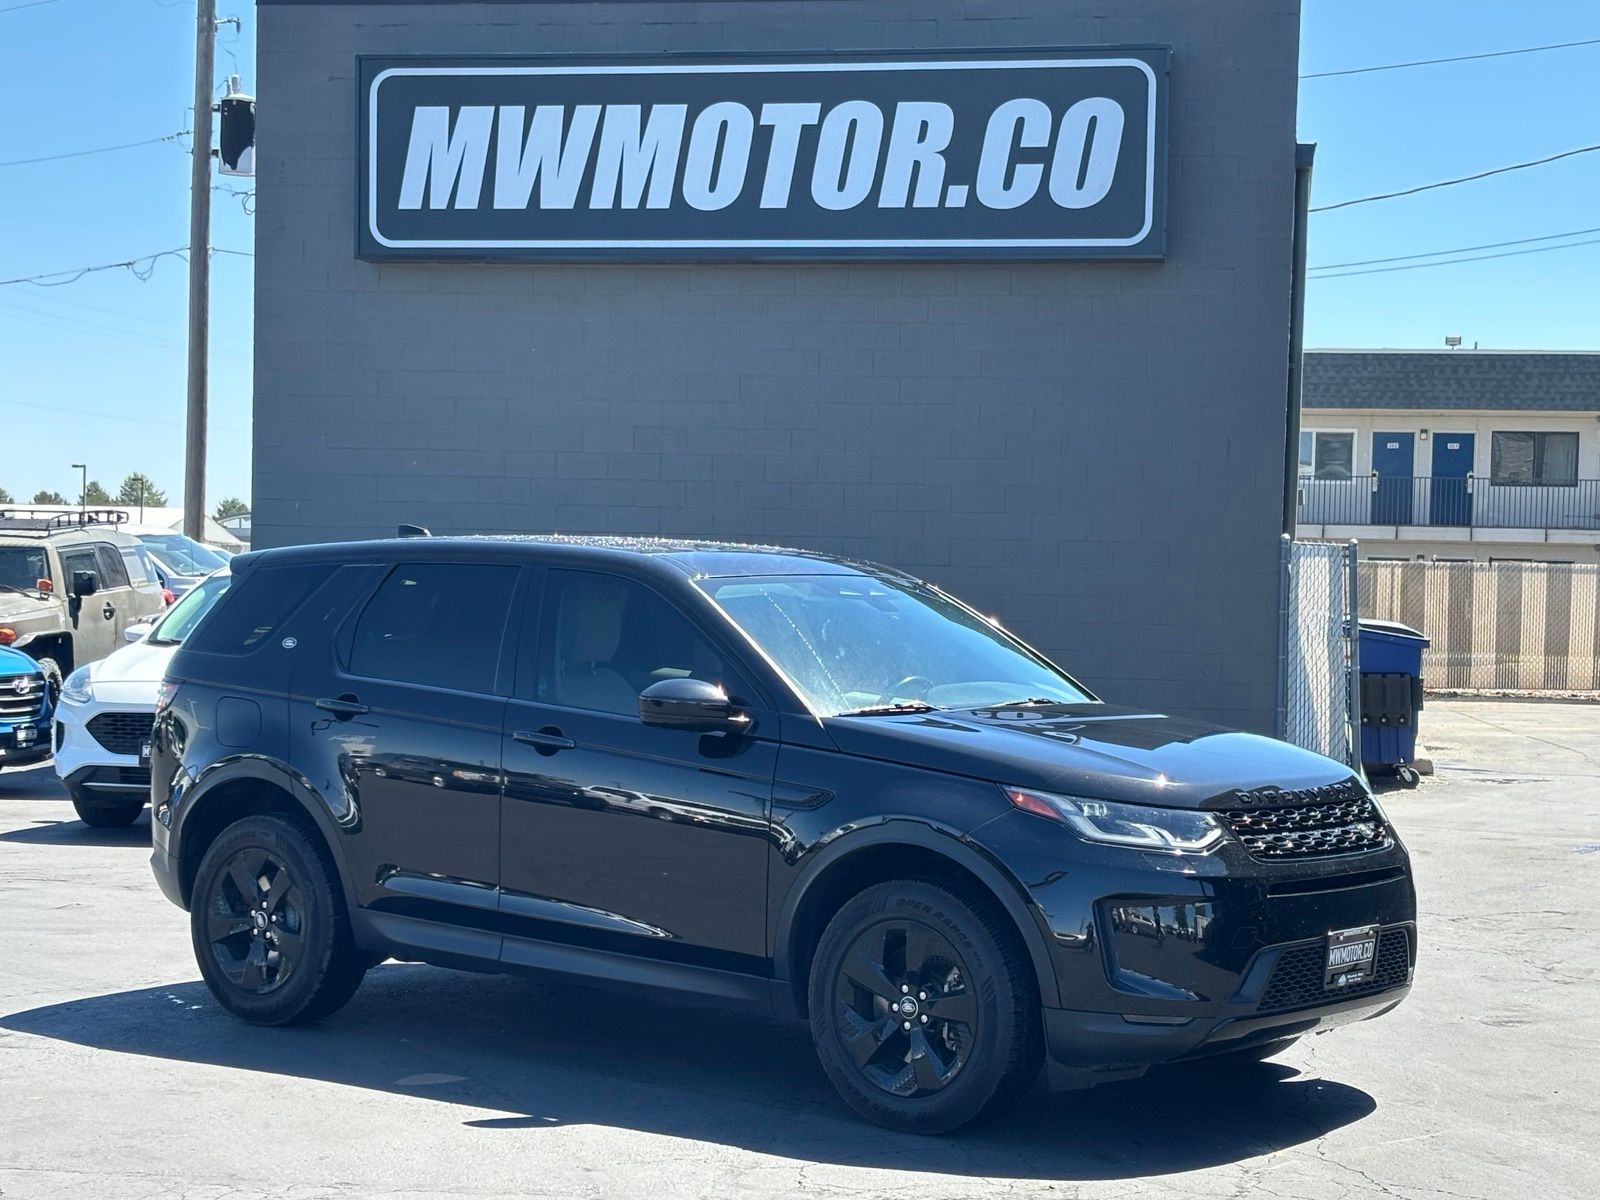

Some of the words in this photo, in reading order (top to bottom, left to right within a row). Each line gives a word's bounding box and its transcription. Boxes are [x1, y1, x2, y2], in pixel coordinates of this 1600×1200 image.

[398, 96, 1126, 212] MWMOTOR.CO
[1235, 782, 1352, 803] DISCOVERY
[896, 899, 932, 913] OPEN
[933, 911, 973, 948] RANGE
[1328, 942, 1373, 966] MWMOTOR.CO
